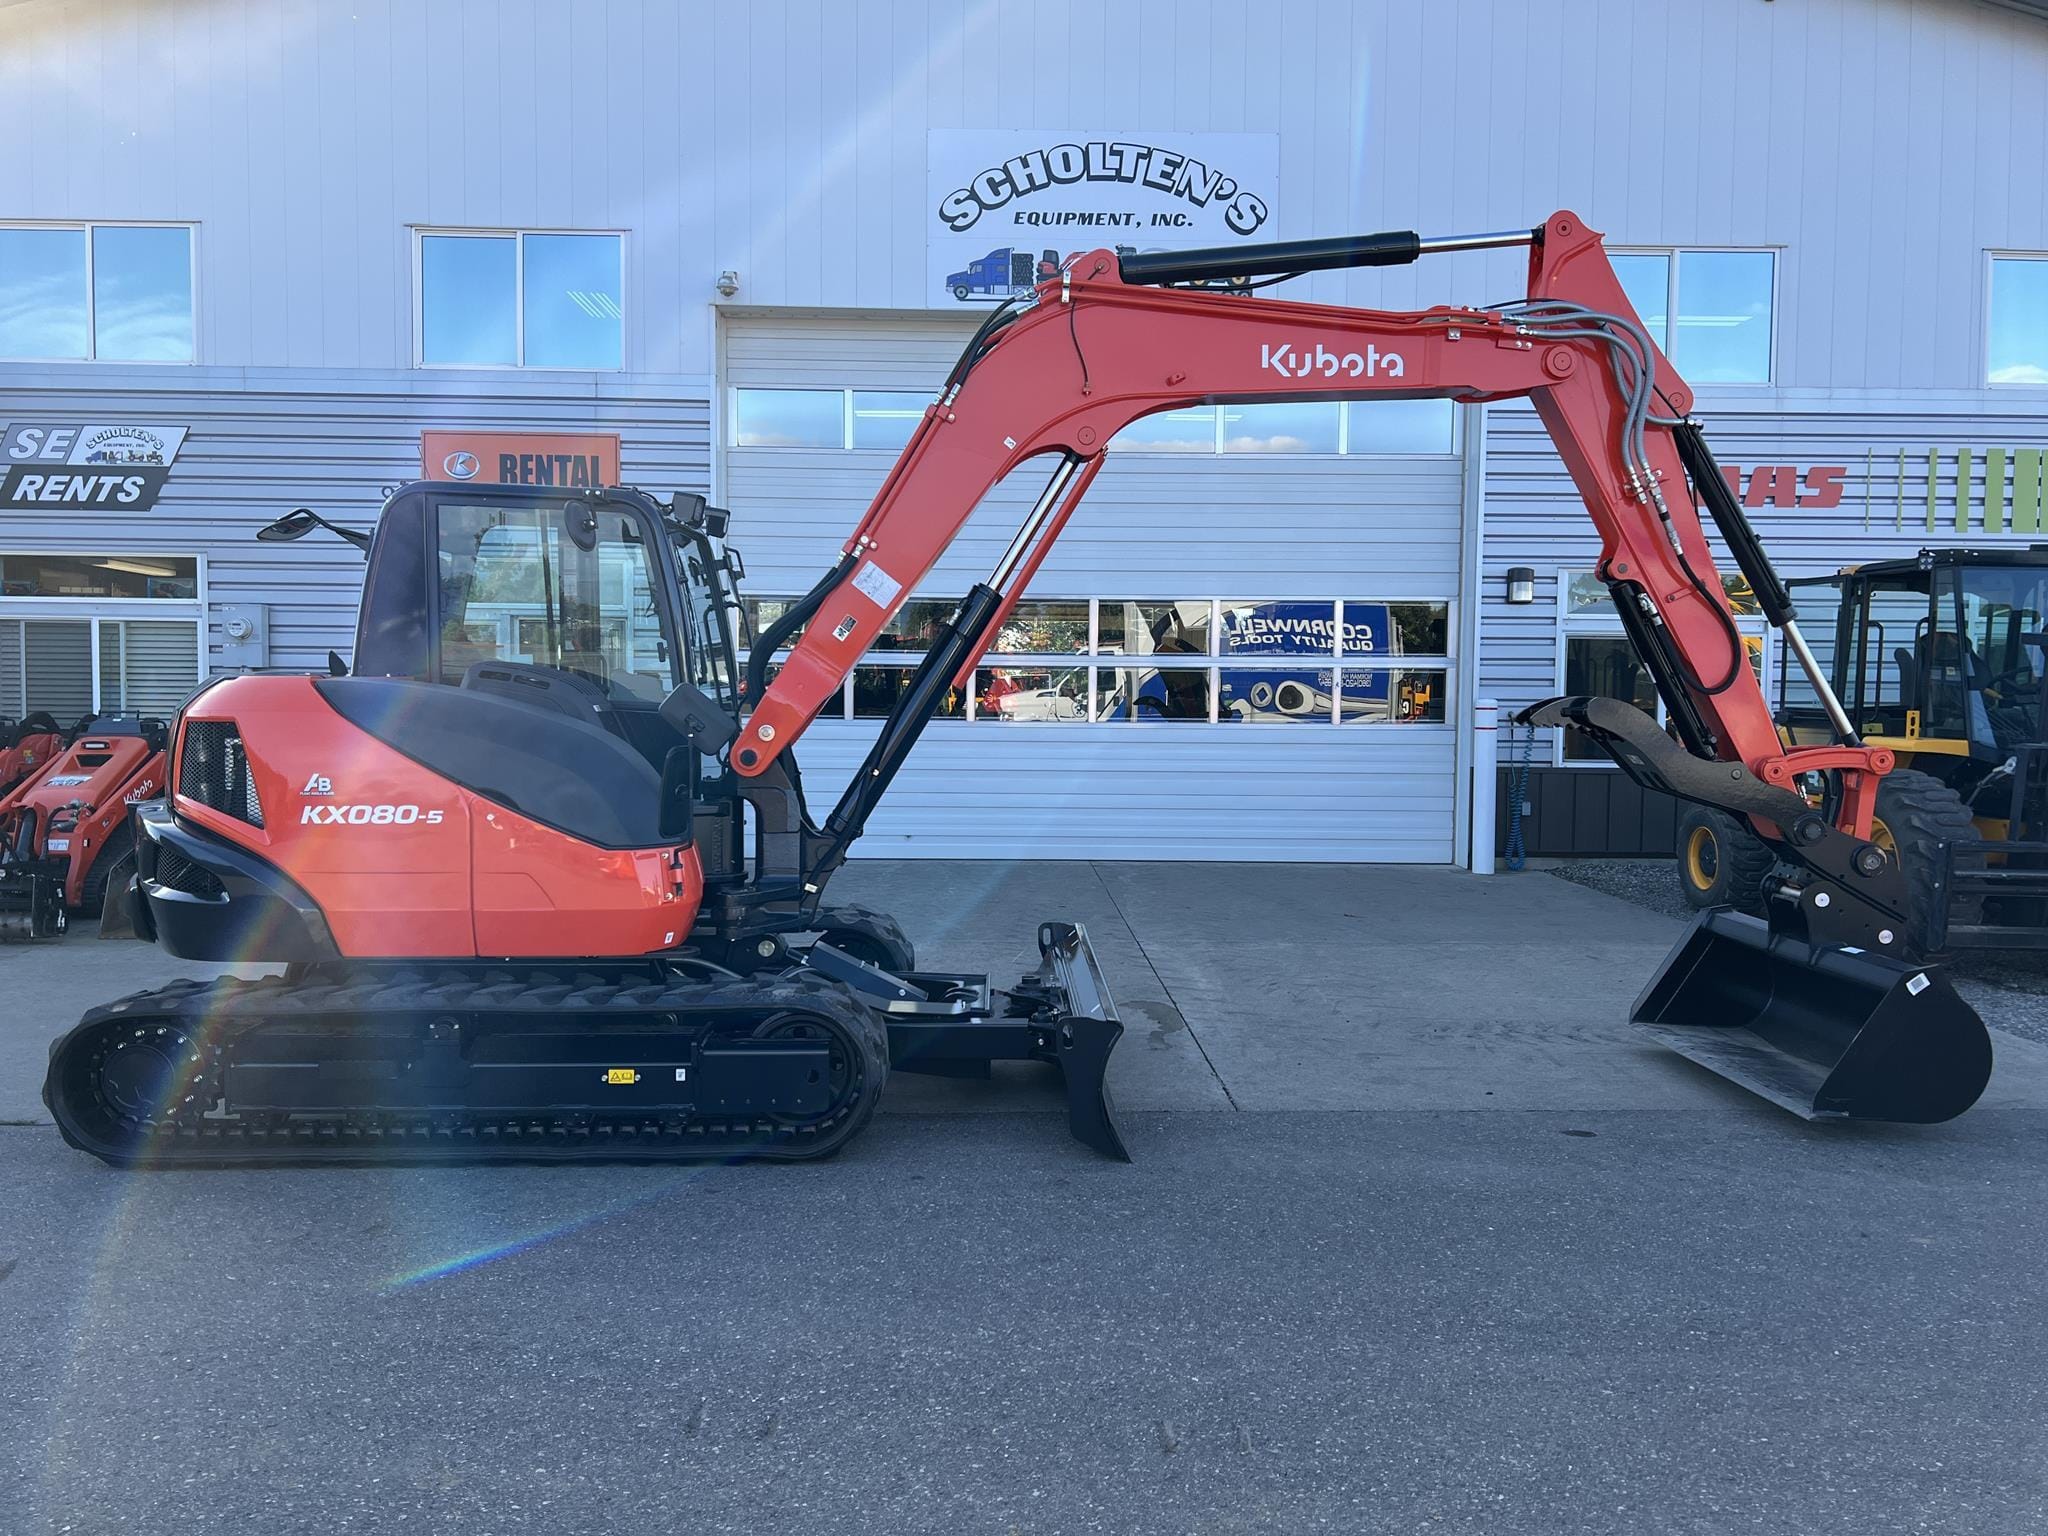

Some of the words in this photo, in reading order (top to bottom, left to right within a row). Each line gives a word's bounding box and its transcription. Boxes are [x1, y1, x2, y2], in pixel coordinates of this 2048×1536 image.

[939, 142, 1268, 235] SCHOLTEN'S
[1013, 211, 1141, 228] EQUIPMENT,
[1150, 213, 1194, 227] INC.
[1261, 344, 1404, 377] Kubota
[8, 428, 77, 459] SE
[85, 426, 164, 450] SCHOLTEN'S
[499, 453, 604, 488] RENTAL
[11, 474, 145, 503] RENTS
[123, 779, 153, 805] Kubota
[304, 773, 332, 792] AB
[300, 805, 444, 824] KX080-5
